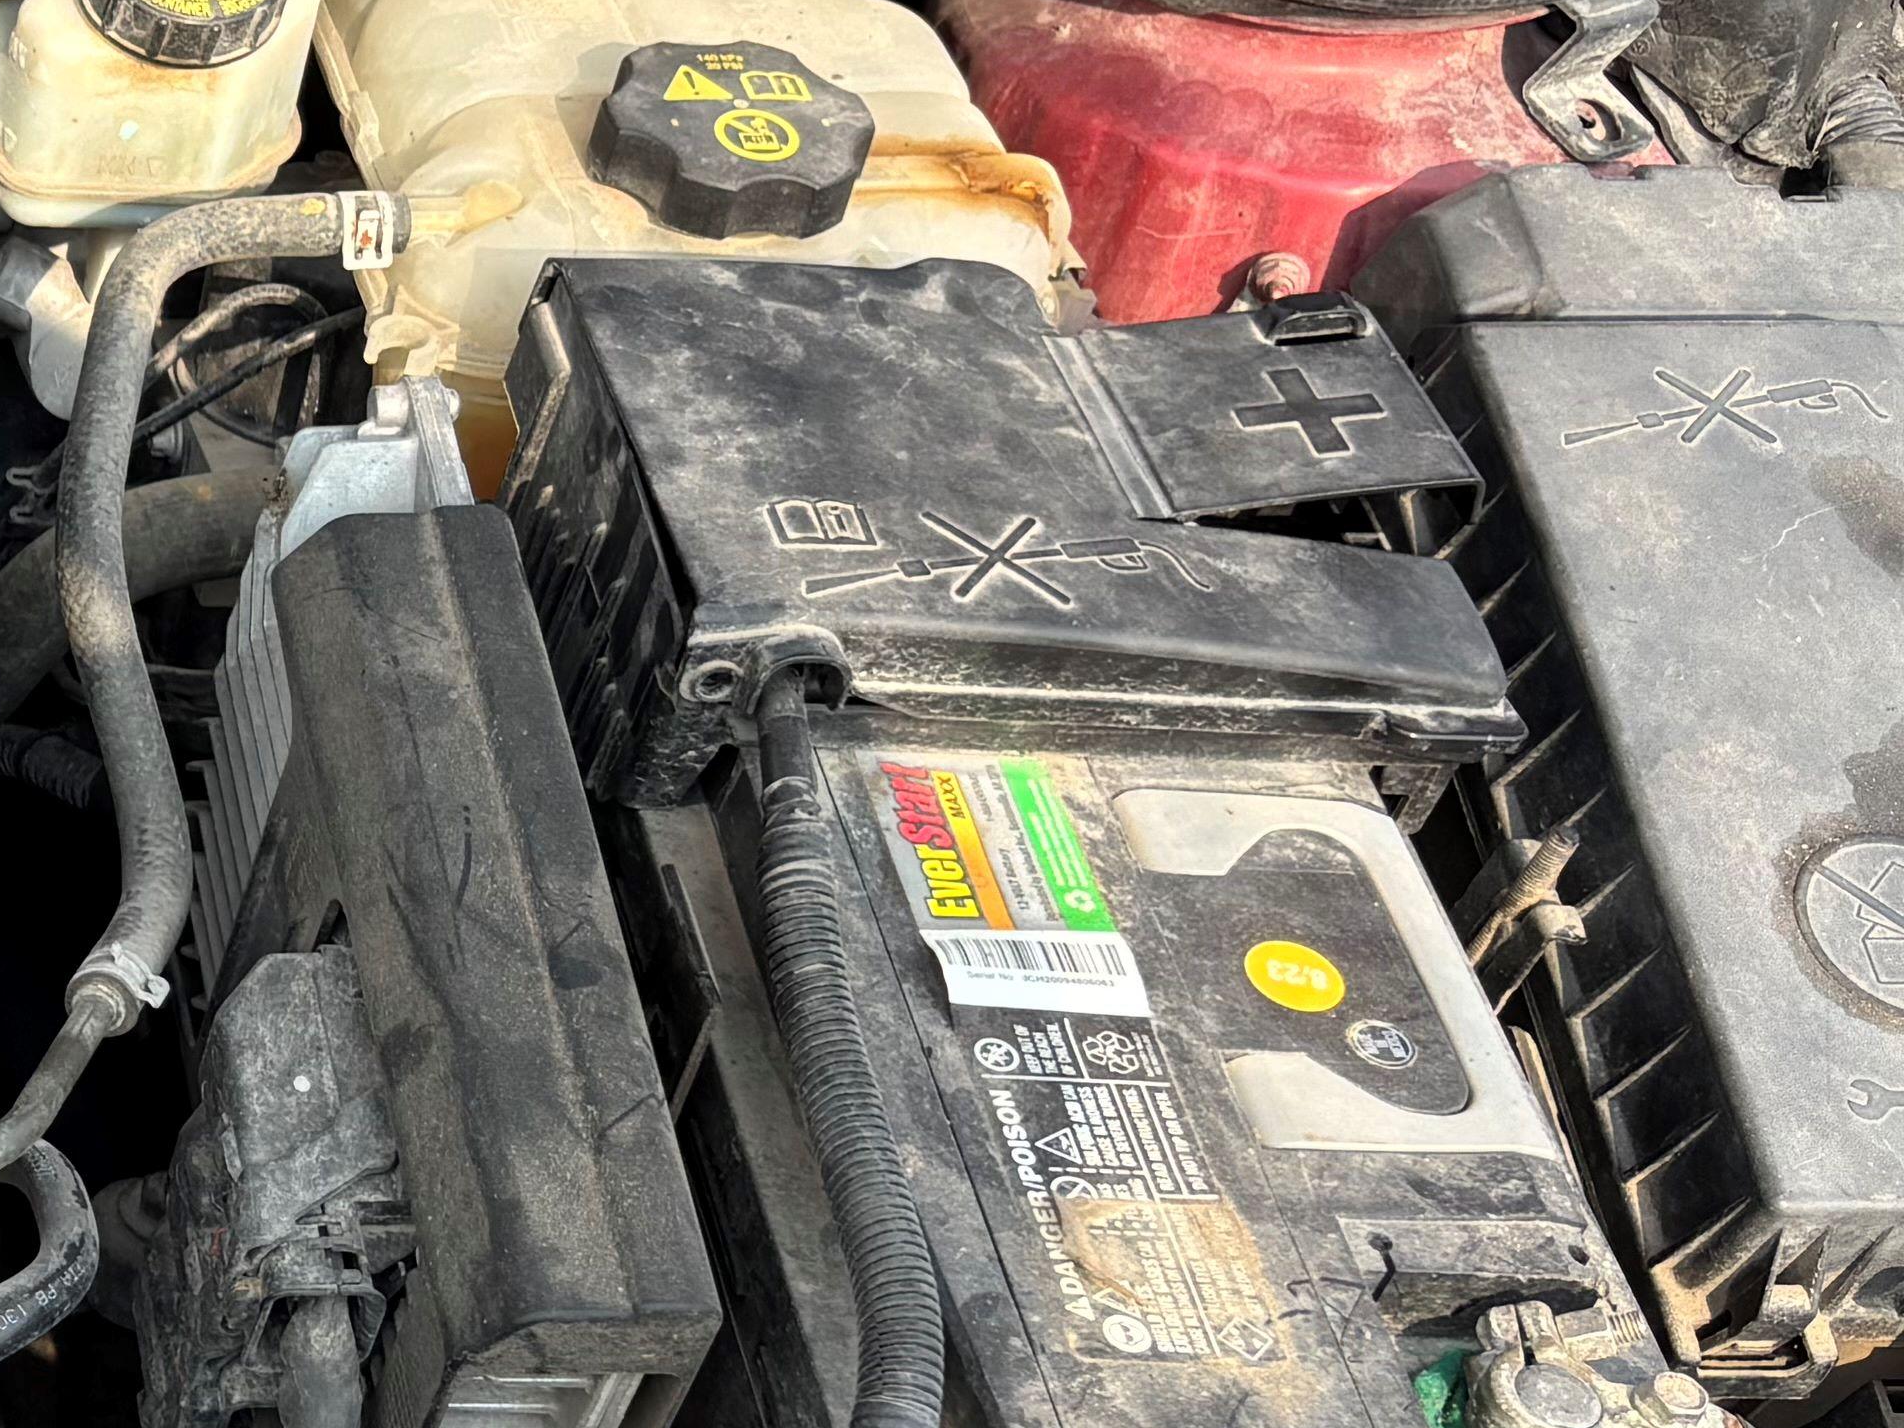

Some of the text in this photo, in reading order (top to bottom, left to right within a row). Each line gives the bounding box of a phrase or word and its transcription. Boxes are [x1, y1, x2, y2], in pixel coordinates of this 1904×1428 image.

[885, 763, 981, 918] EverStart
[936, 774, 966, 819] MAXX
[987, 1088, 1086, 1294] DANGER/POISON
